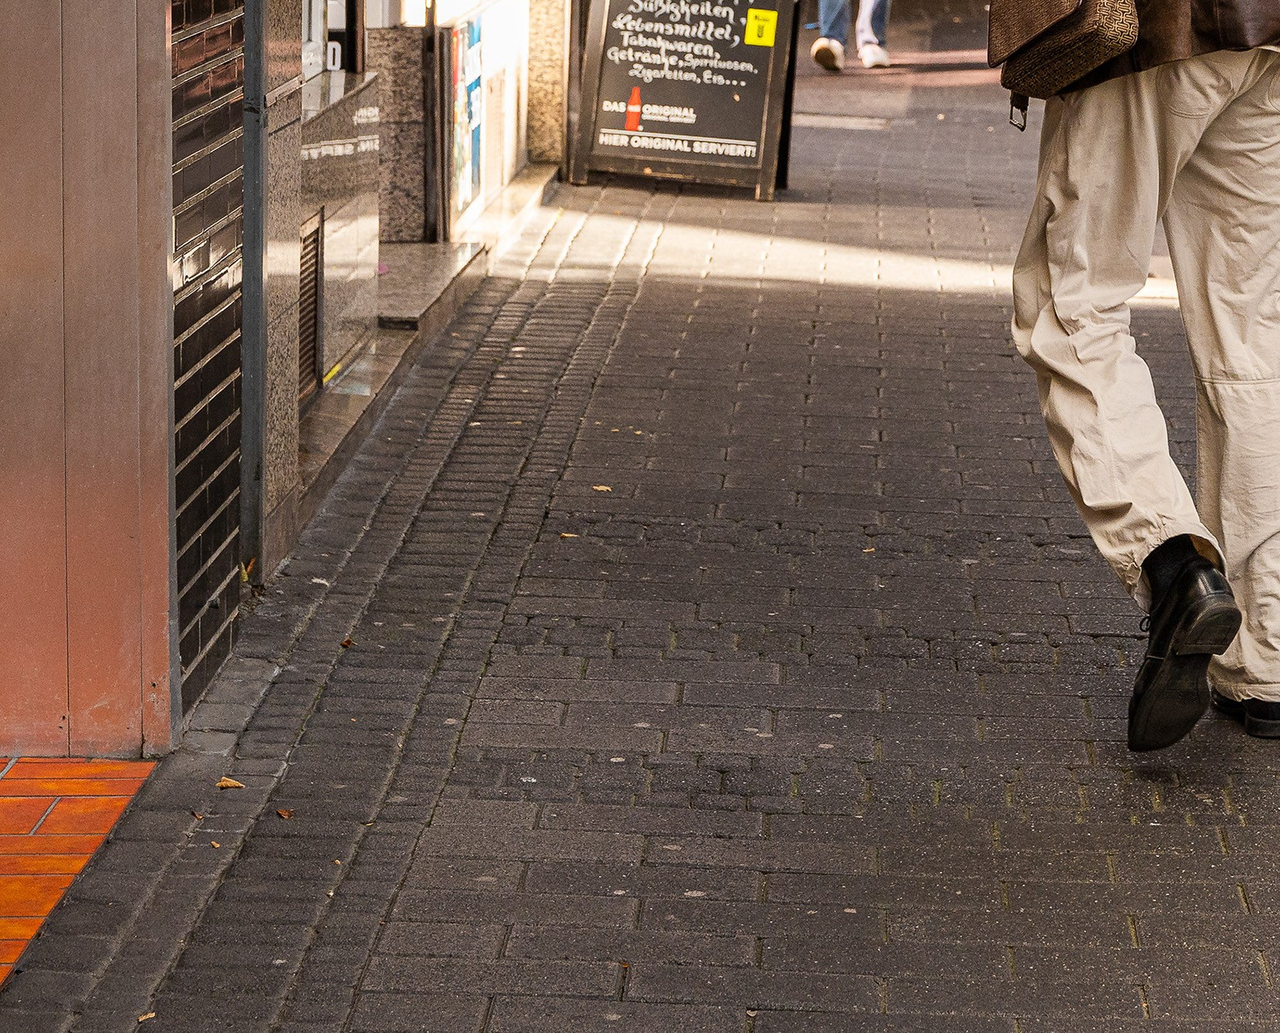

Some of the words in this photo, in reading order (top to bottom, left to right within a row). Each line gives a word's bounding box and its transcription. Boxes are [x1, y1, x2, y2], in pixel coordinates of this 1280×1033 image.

[602, 100, 627, 113] DAS
[641, 103, 697, 118] ORIGINAL
[598, 134, 630, 148] HIER
[630, 136, 692, 153] ORIGINAL
[692, 141, 757, 158] SERVIERT!
